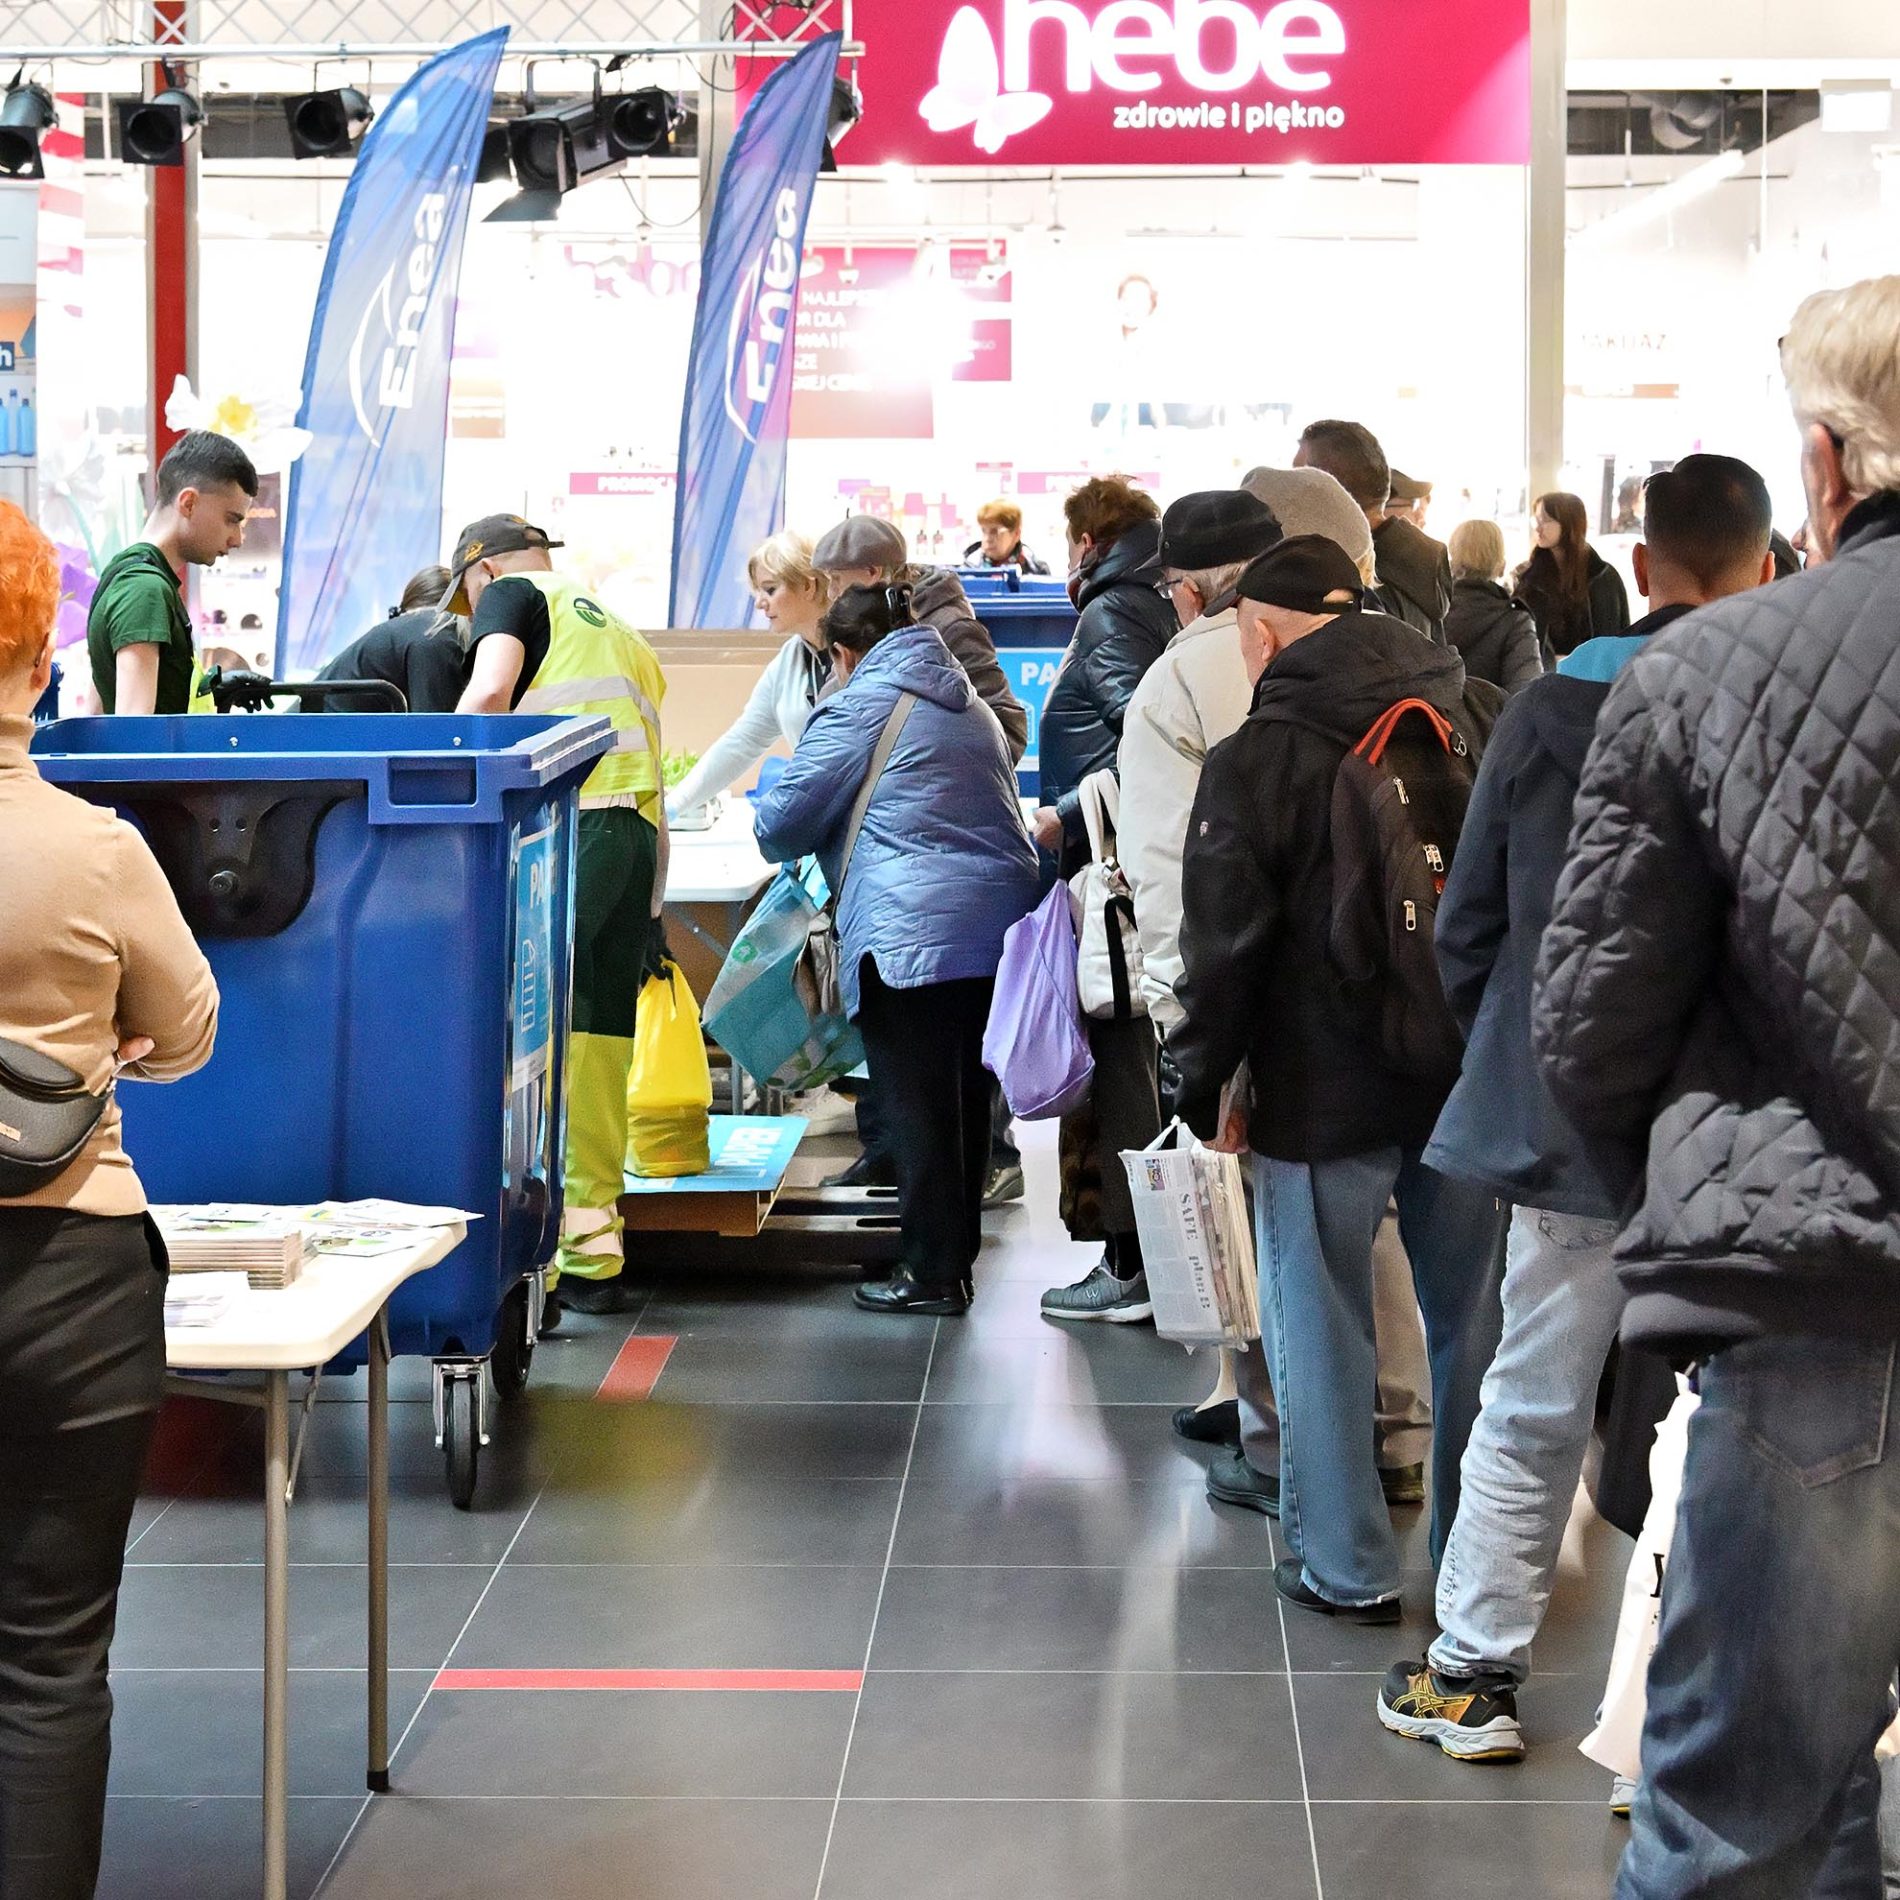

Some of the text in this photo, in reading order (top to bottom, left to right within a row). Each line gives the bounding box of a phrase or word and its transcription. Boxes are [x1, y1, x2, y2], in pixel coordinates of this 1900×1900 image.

[1003, 0, 1346, 93] hebe
[1113, 100, 1345, 134] zdrowie i piękno
[378, 192, 446, 409] Enea
[743, 187, 798, 403] Enea
[1020, 661, 1058, 687] PA
